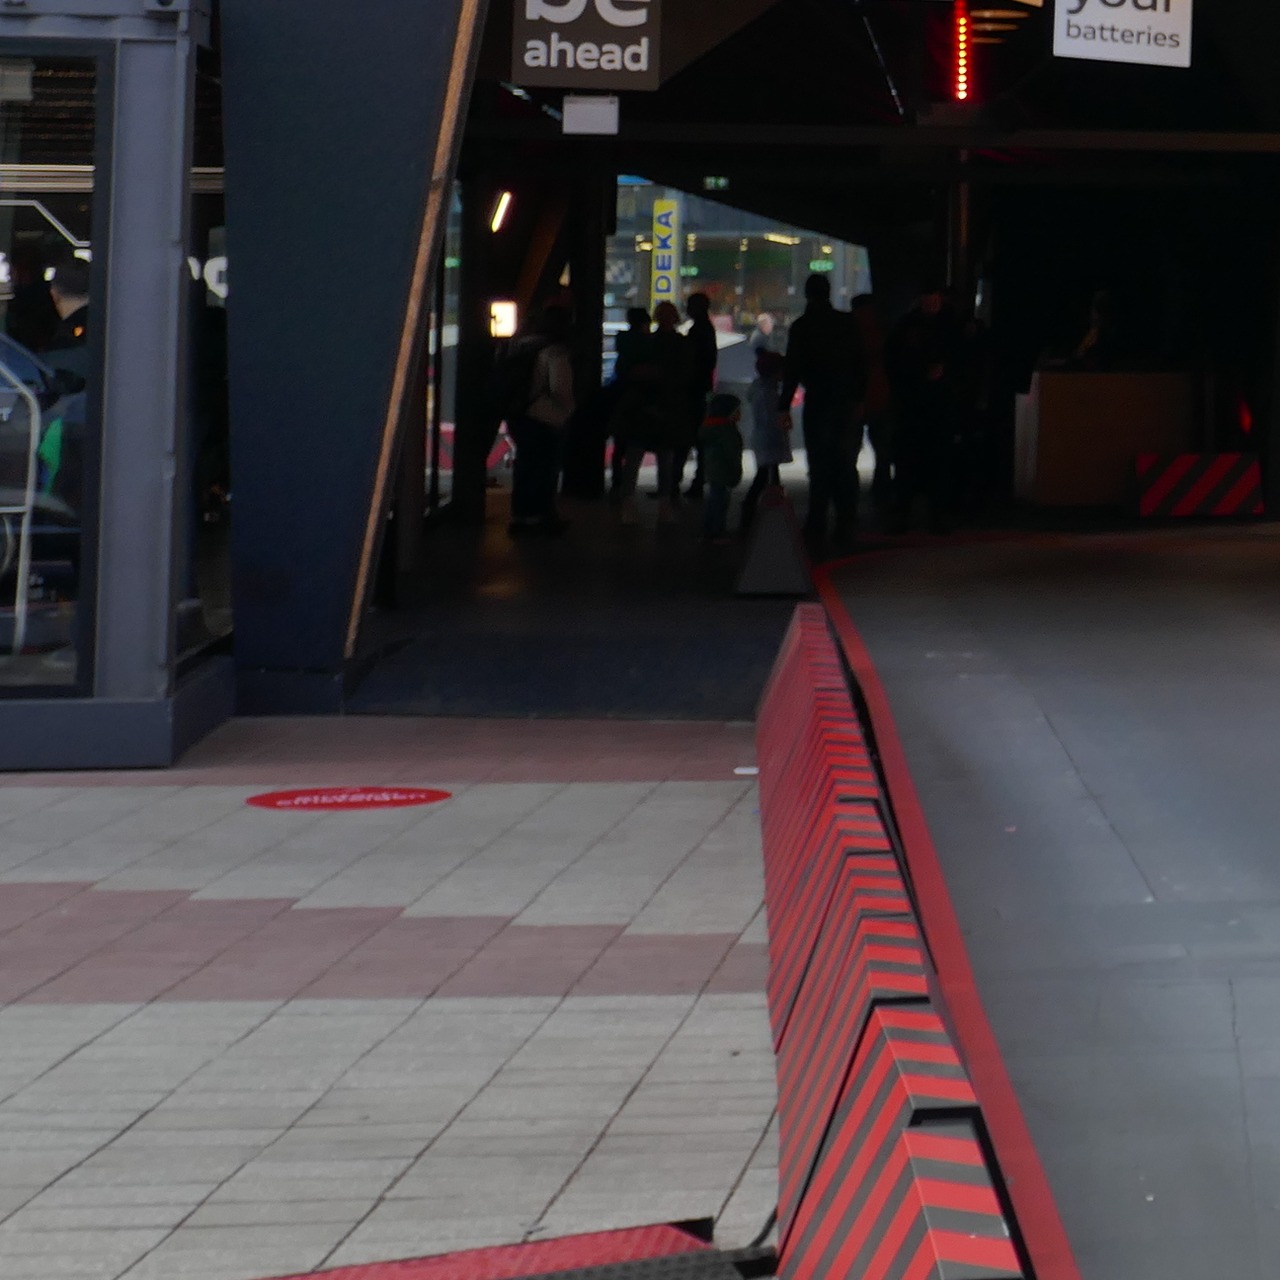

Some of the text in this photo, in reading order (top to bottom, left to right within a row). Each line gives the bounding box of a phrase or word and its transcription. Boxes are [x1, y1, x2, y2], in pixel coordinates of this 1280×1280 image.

[523, 32, 650, 72] ahead
[1065, 19, 1181, 49] batteries
[655, 210, 673, 307] DEKA
